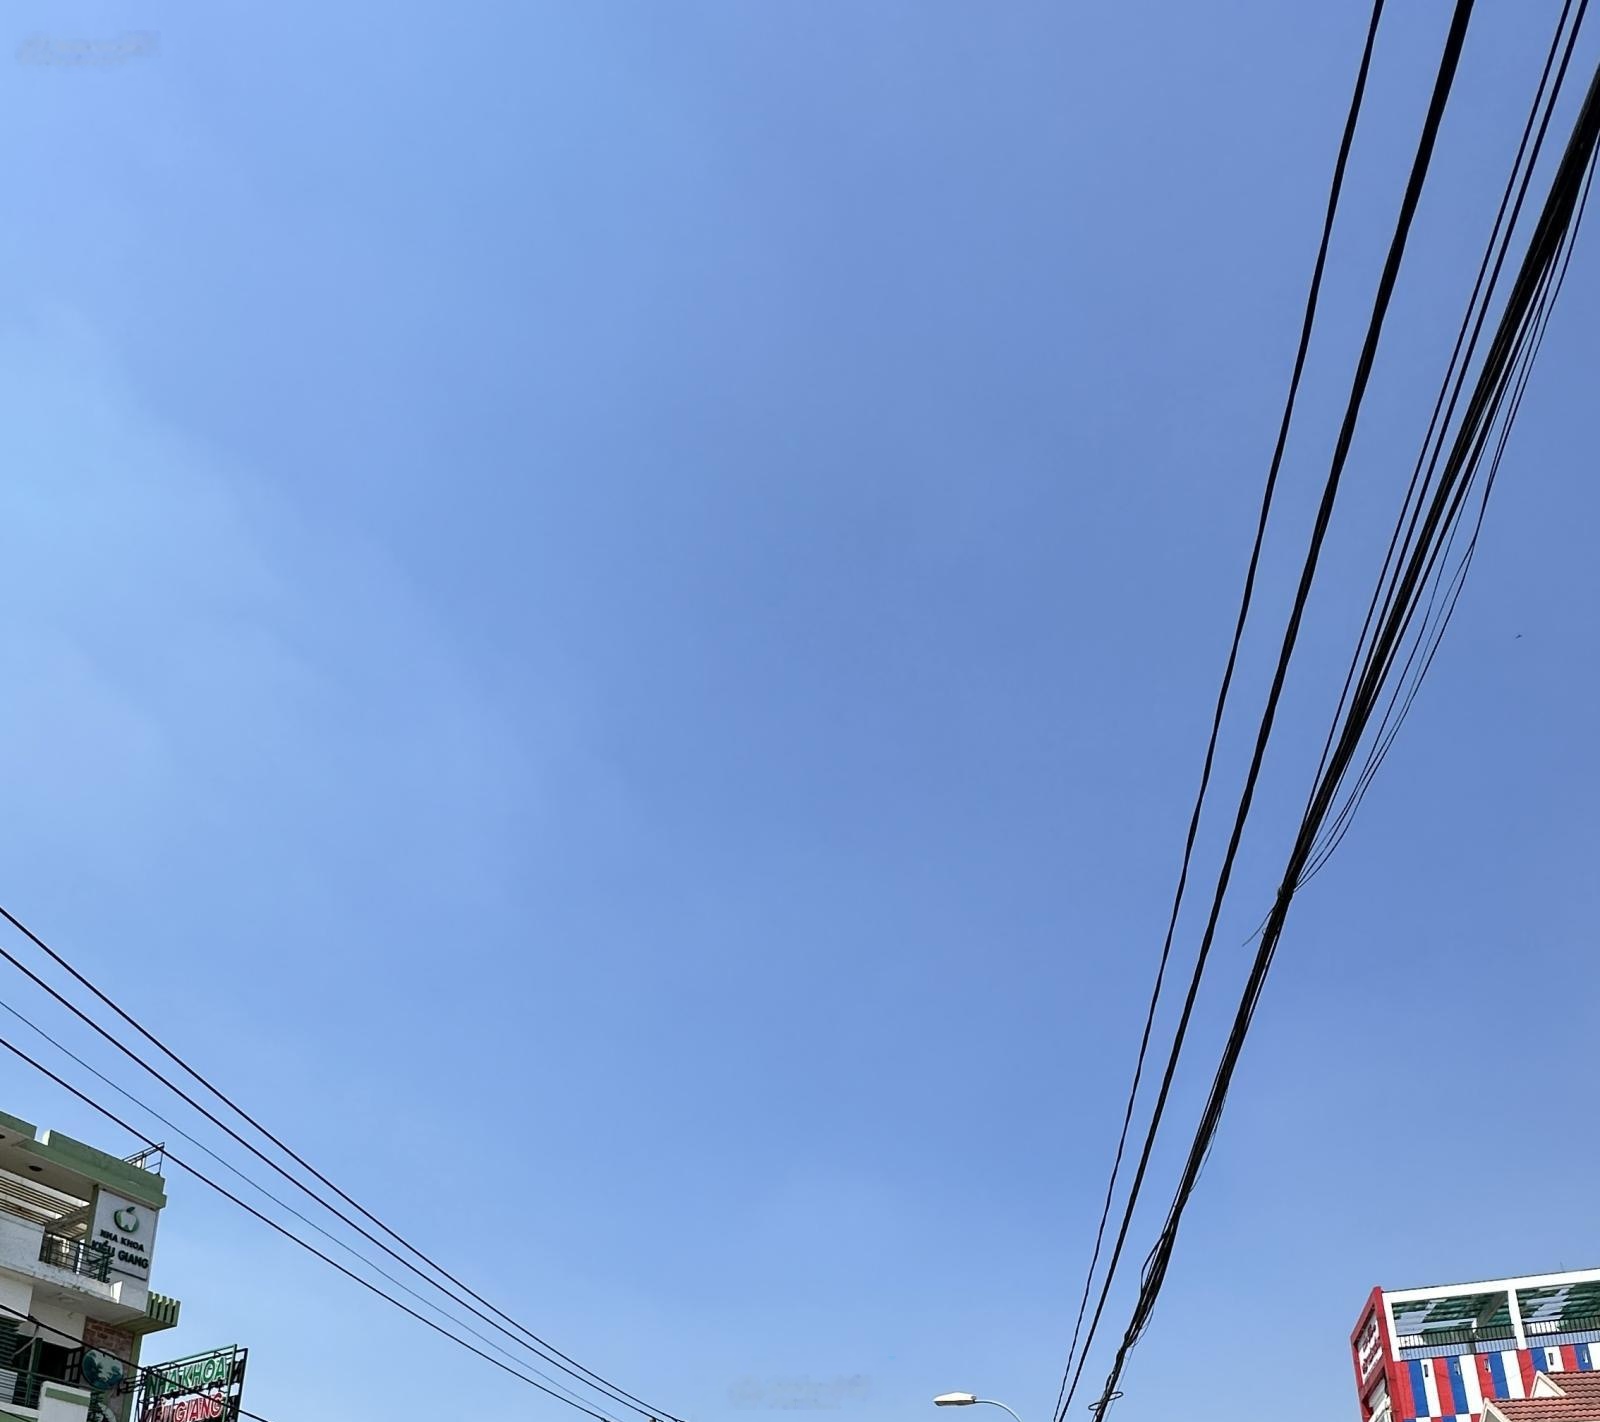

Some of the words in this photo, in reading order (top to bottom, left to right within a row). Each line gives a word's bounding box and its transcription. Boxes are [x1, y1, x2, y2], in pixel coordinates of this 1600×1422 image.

[100, 1229, 118, 1243] NHA
[120, 1237, 144, 1252] KHOA
[118, 1250, 149, 1269] GIANG
[181, 1357, 226, 1389] KHOA
